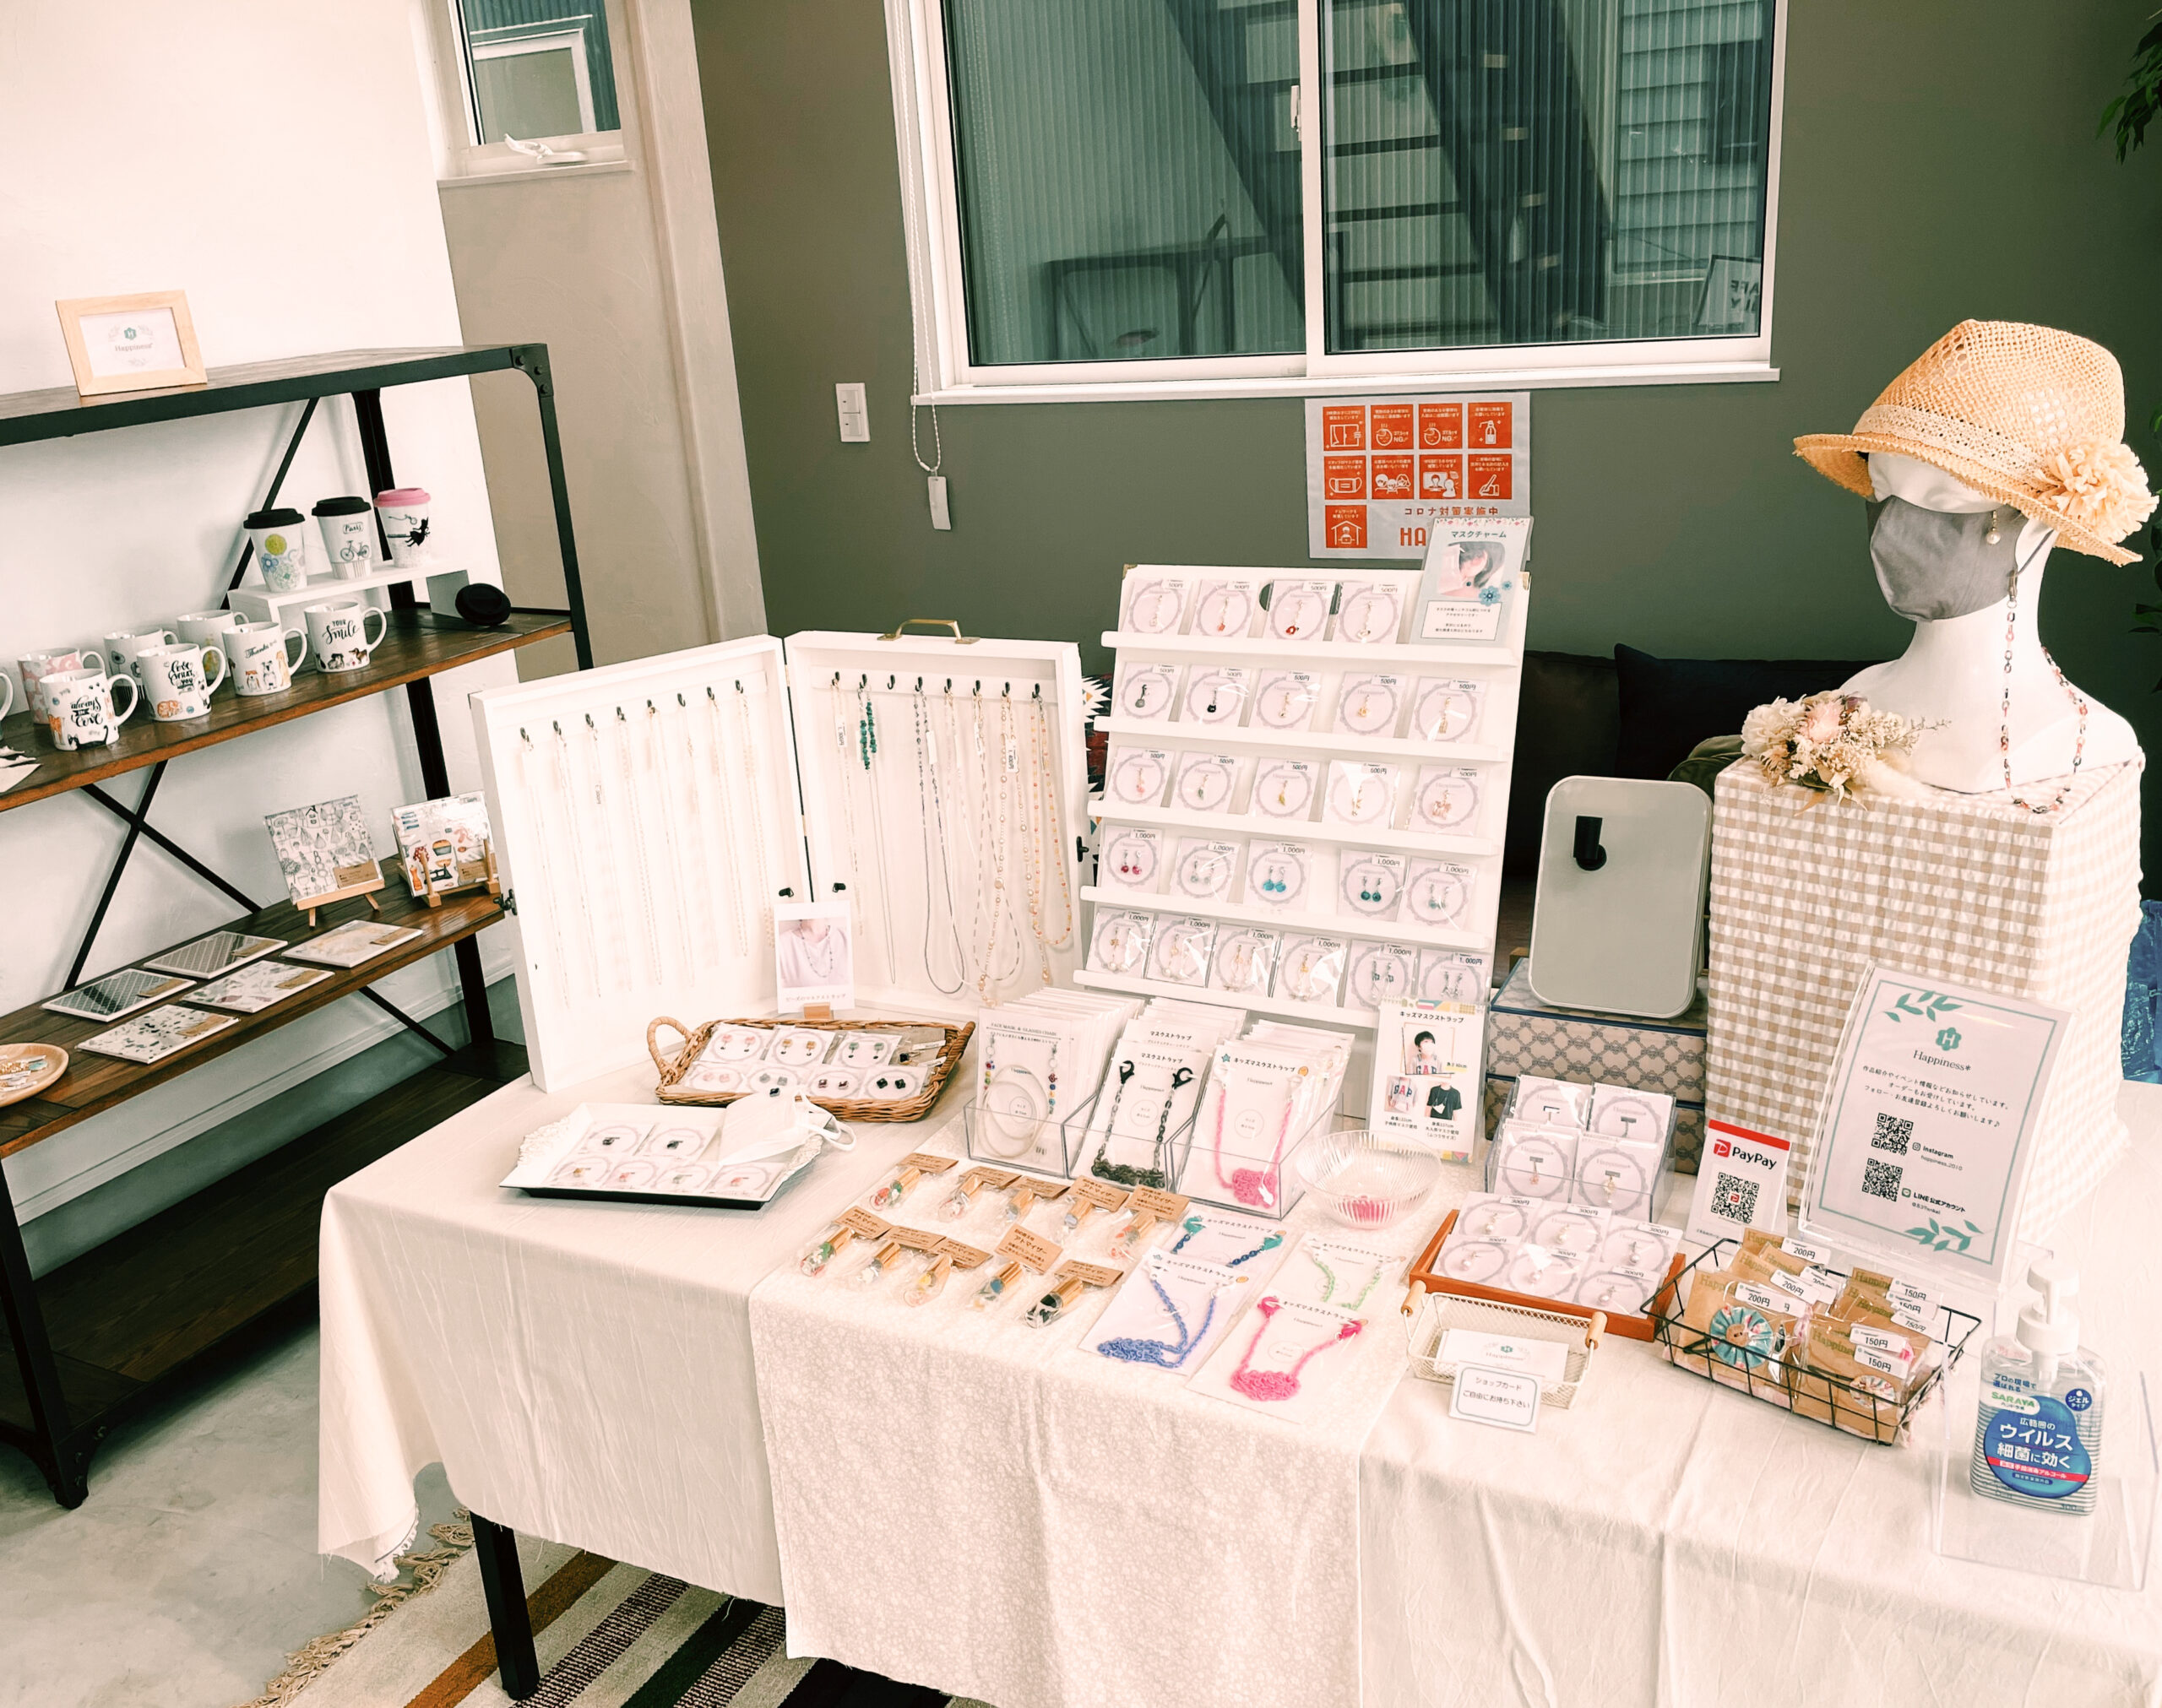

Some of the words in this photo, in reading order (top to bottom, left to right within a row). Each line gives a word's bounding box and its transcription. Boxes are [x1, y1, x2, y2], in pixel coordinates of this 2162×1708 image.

[1404, 507, 1498, 516] コロナ対策実施中
[1400, 528, 1427, 546] HA
[1451, 529, 1507, 539] マスクチャーム
[245, 644, 269, 659] Thanks
[1399, 1011, 1464, 1023] キッズマスクストラップ
[1234, 1057, 1296, 1072] キッズマスクストラップ
[1731, 1147, 1778, 1170] PayPay
[1922, 1146, 1954, 1160] Instagram
[1913, 1191, 1930, 1202] LINE
[1930, 1195, 1966, 1213] 公式アカウント
[1793, 1246, 1816, 1259] 200円
[1782, 1281, 1805, 1296] 200円
[1904, 1288, 1926, 1301] 150円
[1747, 1293, 1771, 1307] 200円
[1905, 1320, 1926, 1332] 150円
[1866, 1337, 1888, 1348] 150円
[1868, 1358, 1892, 1373] 150円
[1475, 1376, 1522, 1391] ショップカード
[1463, 1390, 1530, 1408] ご自由にお持ち下さい
[1991, 1391, 2035, 1408] SARAYA
[2067, 1395, 2090, 1405] ジェル
[2019, 1417, 2056, 1431] 広範囲の
[2000, 1423, 2073, 1451] ウイルス
[1996, 1442, 2071, 1469] 細菌に効く
